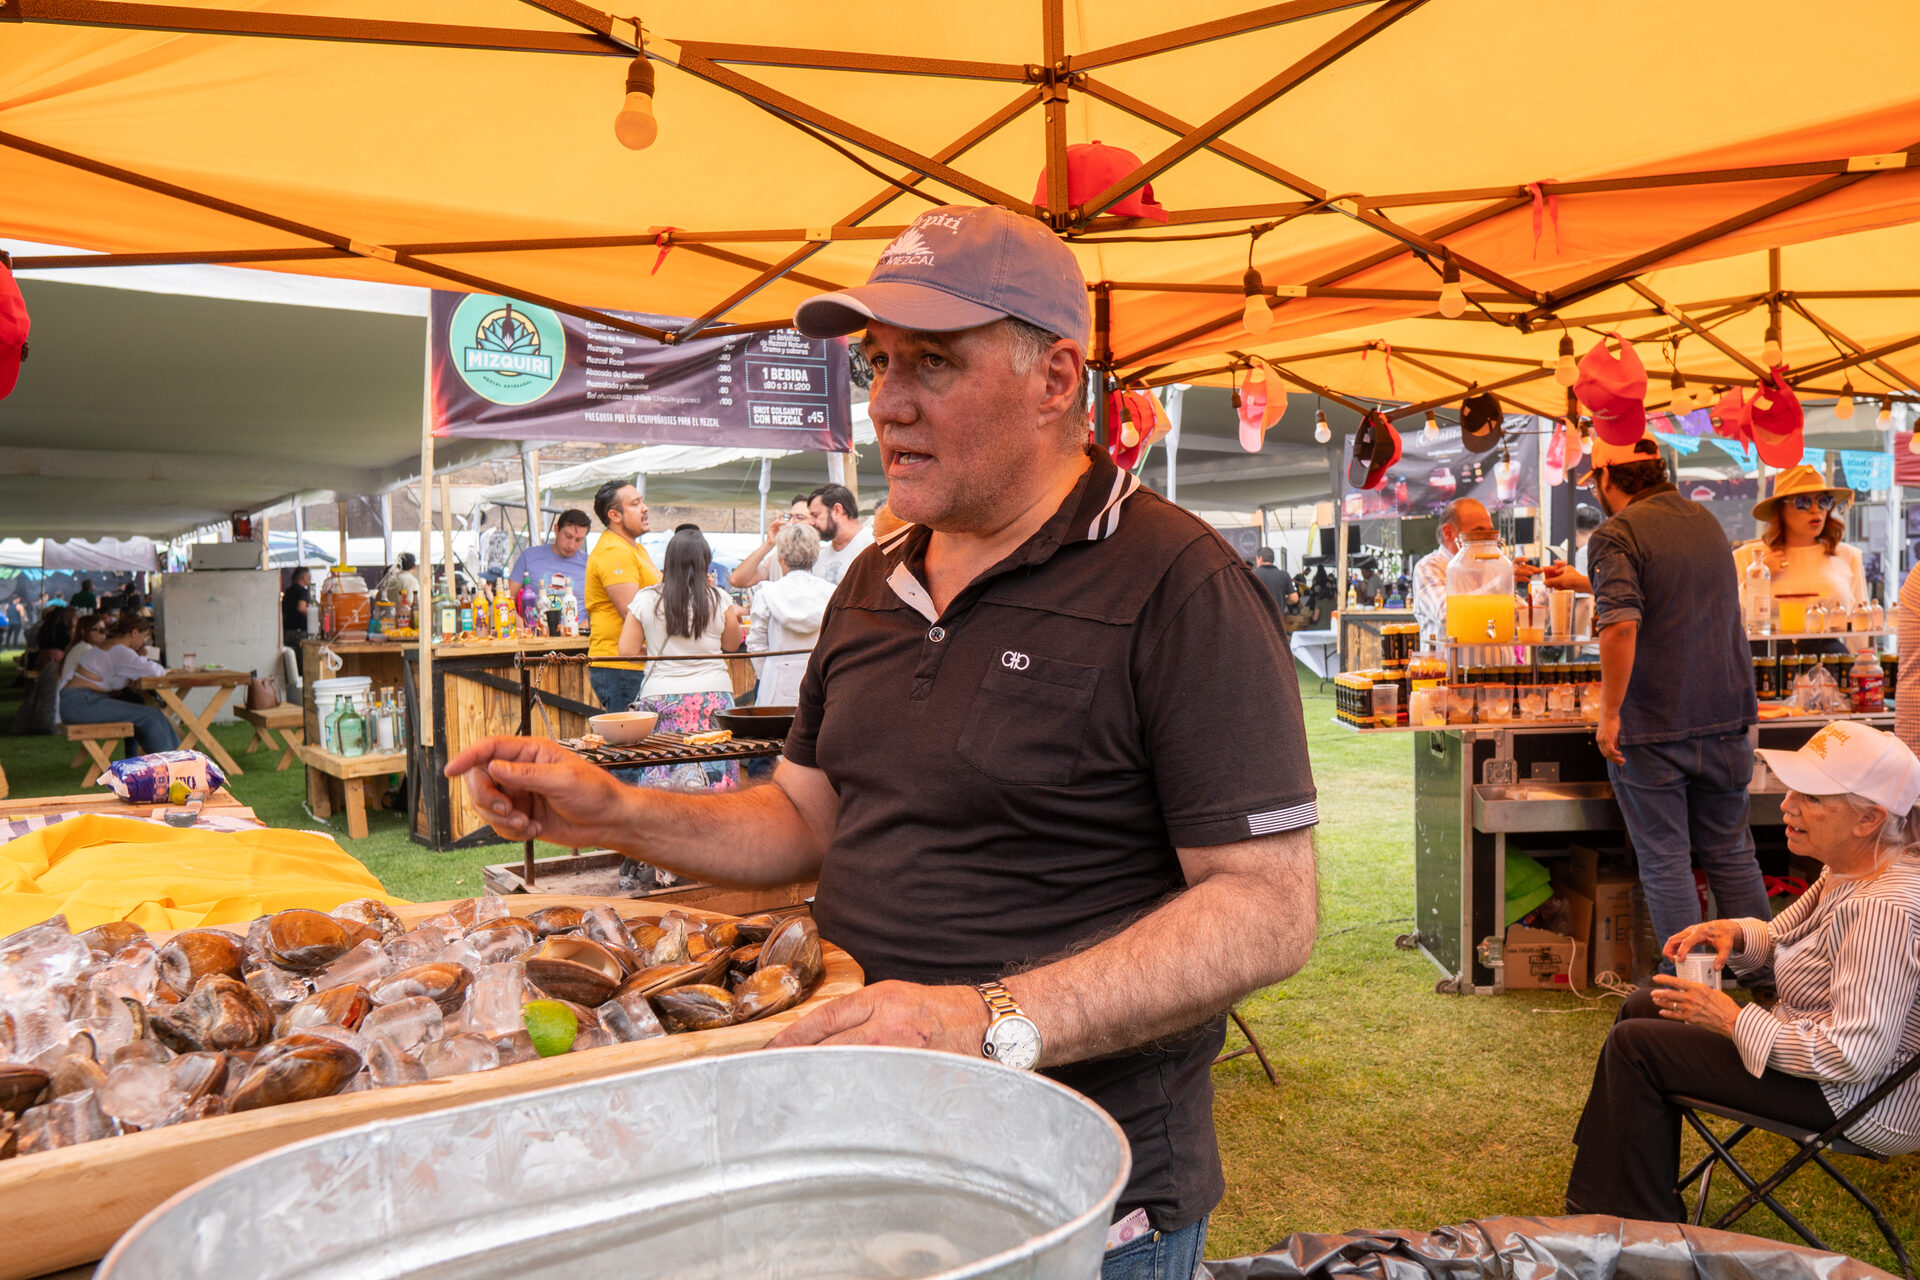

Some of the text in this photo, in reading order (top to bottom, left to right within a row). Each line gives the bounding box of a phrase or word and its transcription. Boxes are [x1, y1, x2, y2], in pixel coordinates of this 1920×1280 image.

[886, 255, 935, 267] MEZCAL
[616, 336, 636, 345] Mezcal
[768, 340, 787, 348] Mezcal
[468, 351, 549, 376] MIZQUIRI
[586, 355, 608, 365] Mezcal
[608, 357, 625, 367] Rosa
[612, 370, 621, 378] de
[762, 366, 808, 381] 1 BEBIDA
[783, 382, 788, 390] 3
[794, 383, 811, 392] $200
[586, 391, 597, 400] Sal
[753, 405, 803, 415] SHOT COLGANTE
[584, 412, 613, 423] PREGUNTA
[614, 413, 625, 423] POR
[626, 414, 637, 424] LOS
[677, 416, 692, 426] PARA
[692, 417, 700, 427] EL
[700, 417, 720, 427] MEZCAL
[754, 414, 803, 425] CON MEZCAL
[807, 411, 824, 424] $45
